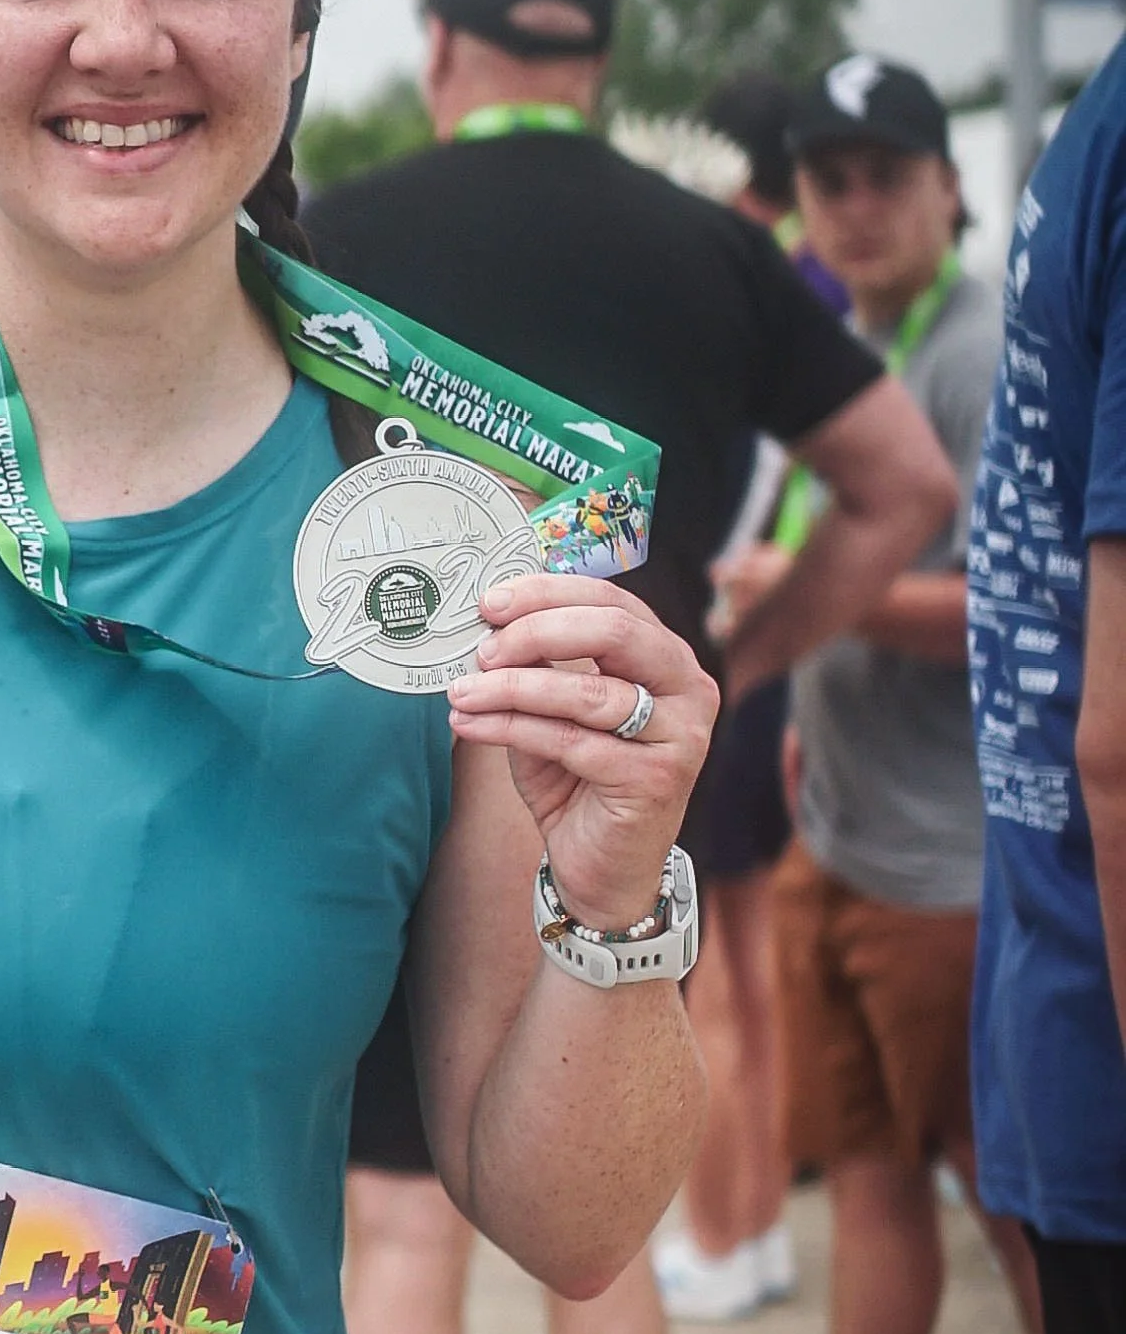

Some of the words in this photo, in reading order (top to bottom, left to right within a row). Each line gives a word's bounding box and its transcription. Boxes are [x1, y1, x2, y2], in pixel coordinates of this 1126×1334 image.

[411, 355, 491, 407] OKLAHOMA
[495, 399, 533, 426] CITY
[400, 371, 524, 452] MEMORIAL
[315, 458, 430, 526] TWENTY-SIXTH
[434, 462, 497, 503] ANNUAL
[20, 507, 49, 535] CITY
[380, 597, 426, 612] MEMORIAL
[382, 607, 427, 622] MARATHON
[404, 669, 442, 687] April
[448, 663, 467, 681] 26
